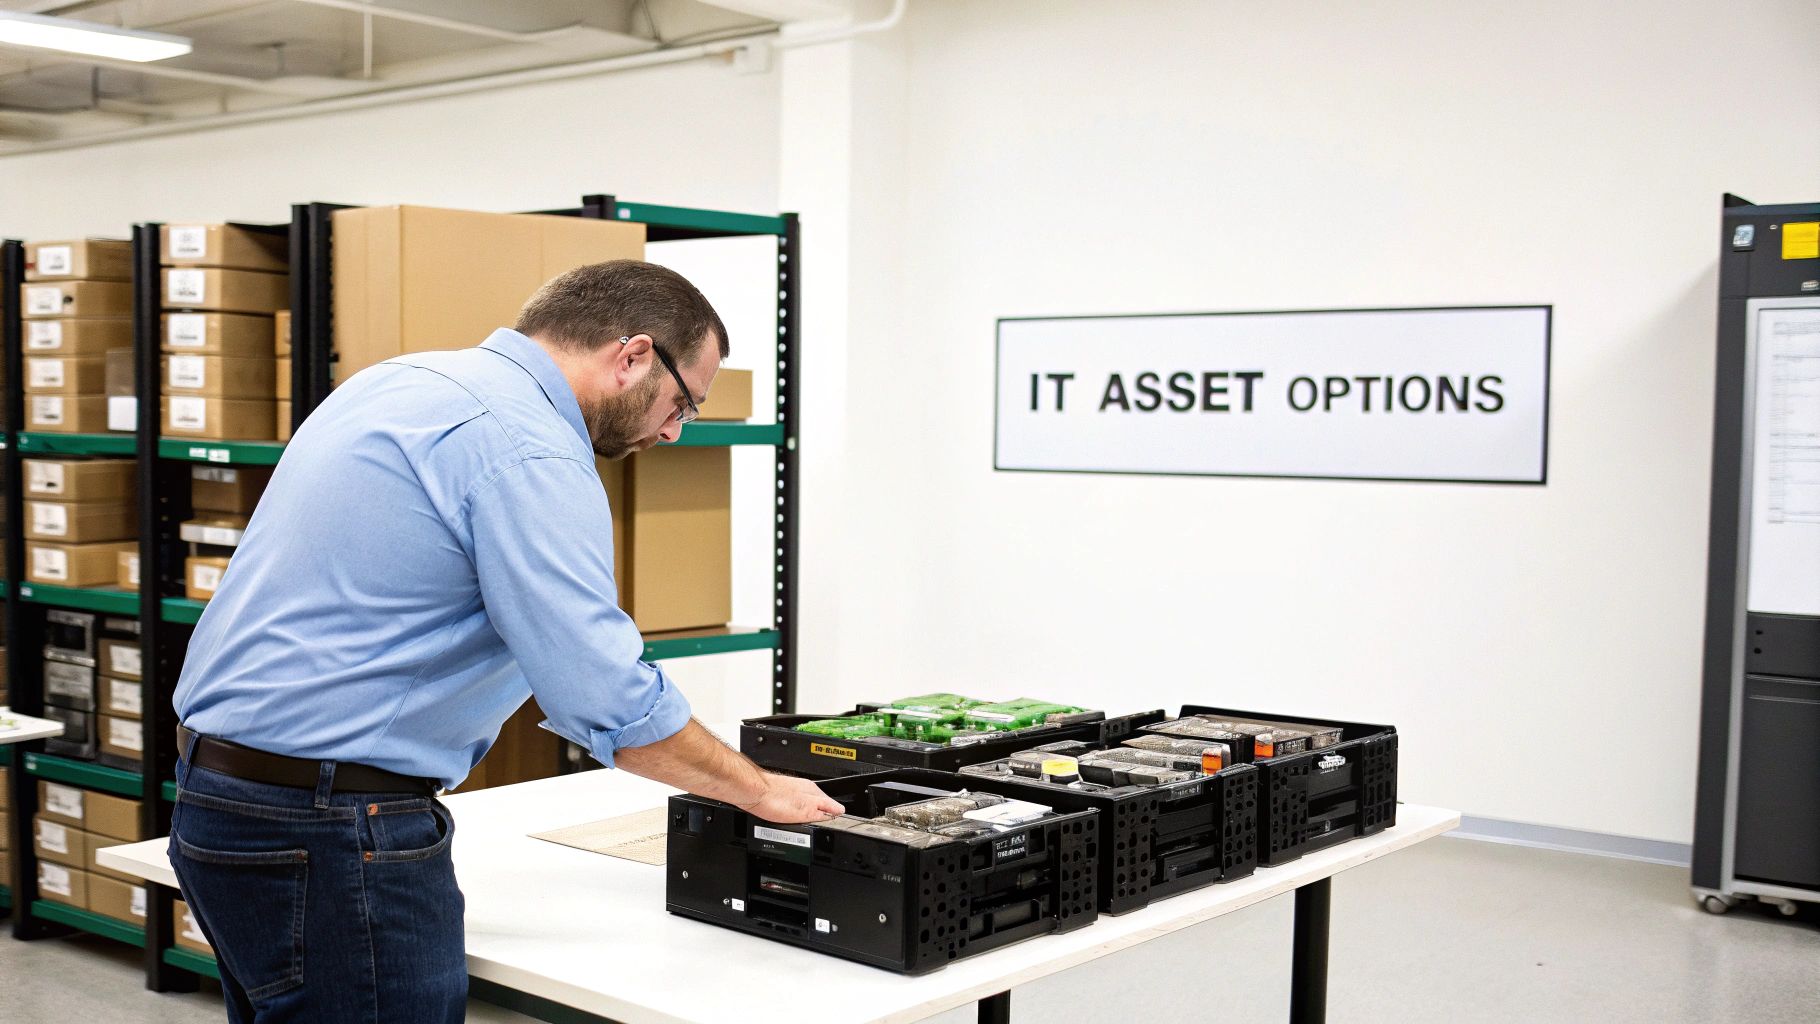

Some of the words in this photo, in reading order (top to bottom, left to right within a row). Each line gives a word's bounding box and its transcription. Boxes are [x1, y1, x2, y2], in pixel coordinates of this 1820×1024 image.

[1030, 373, 1075, 412] IT
[1099, 371, 1264, 413] ASSET
[1287, 375, 1504, 413] OPTIONS
